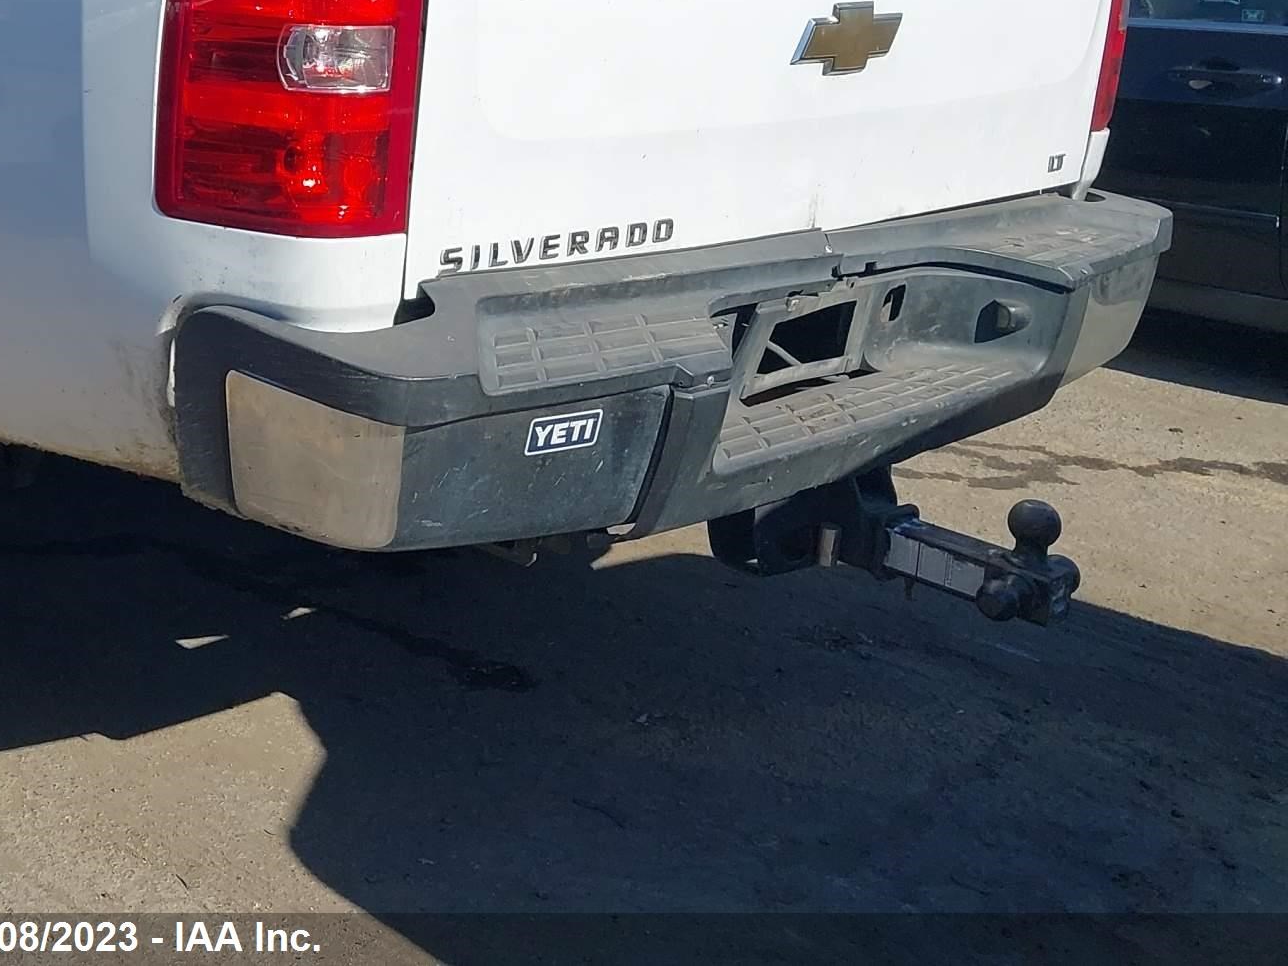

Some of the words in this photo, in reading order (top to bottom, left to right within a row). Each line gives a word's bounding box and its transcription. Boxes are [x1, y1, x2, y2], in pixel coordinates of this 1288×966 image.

[1047, 153, 1067, 173] LT
[439, 217, 674, 273] SILVERADO
[534, 417, 598, 447] YETI
